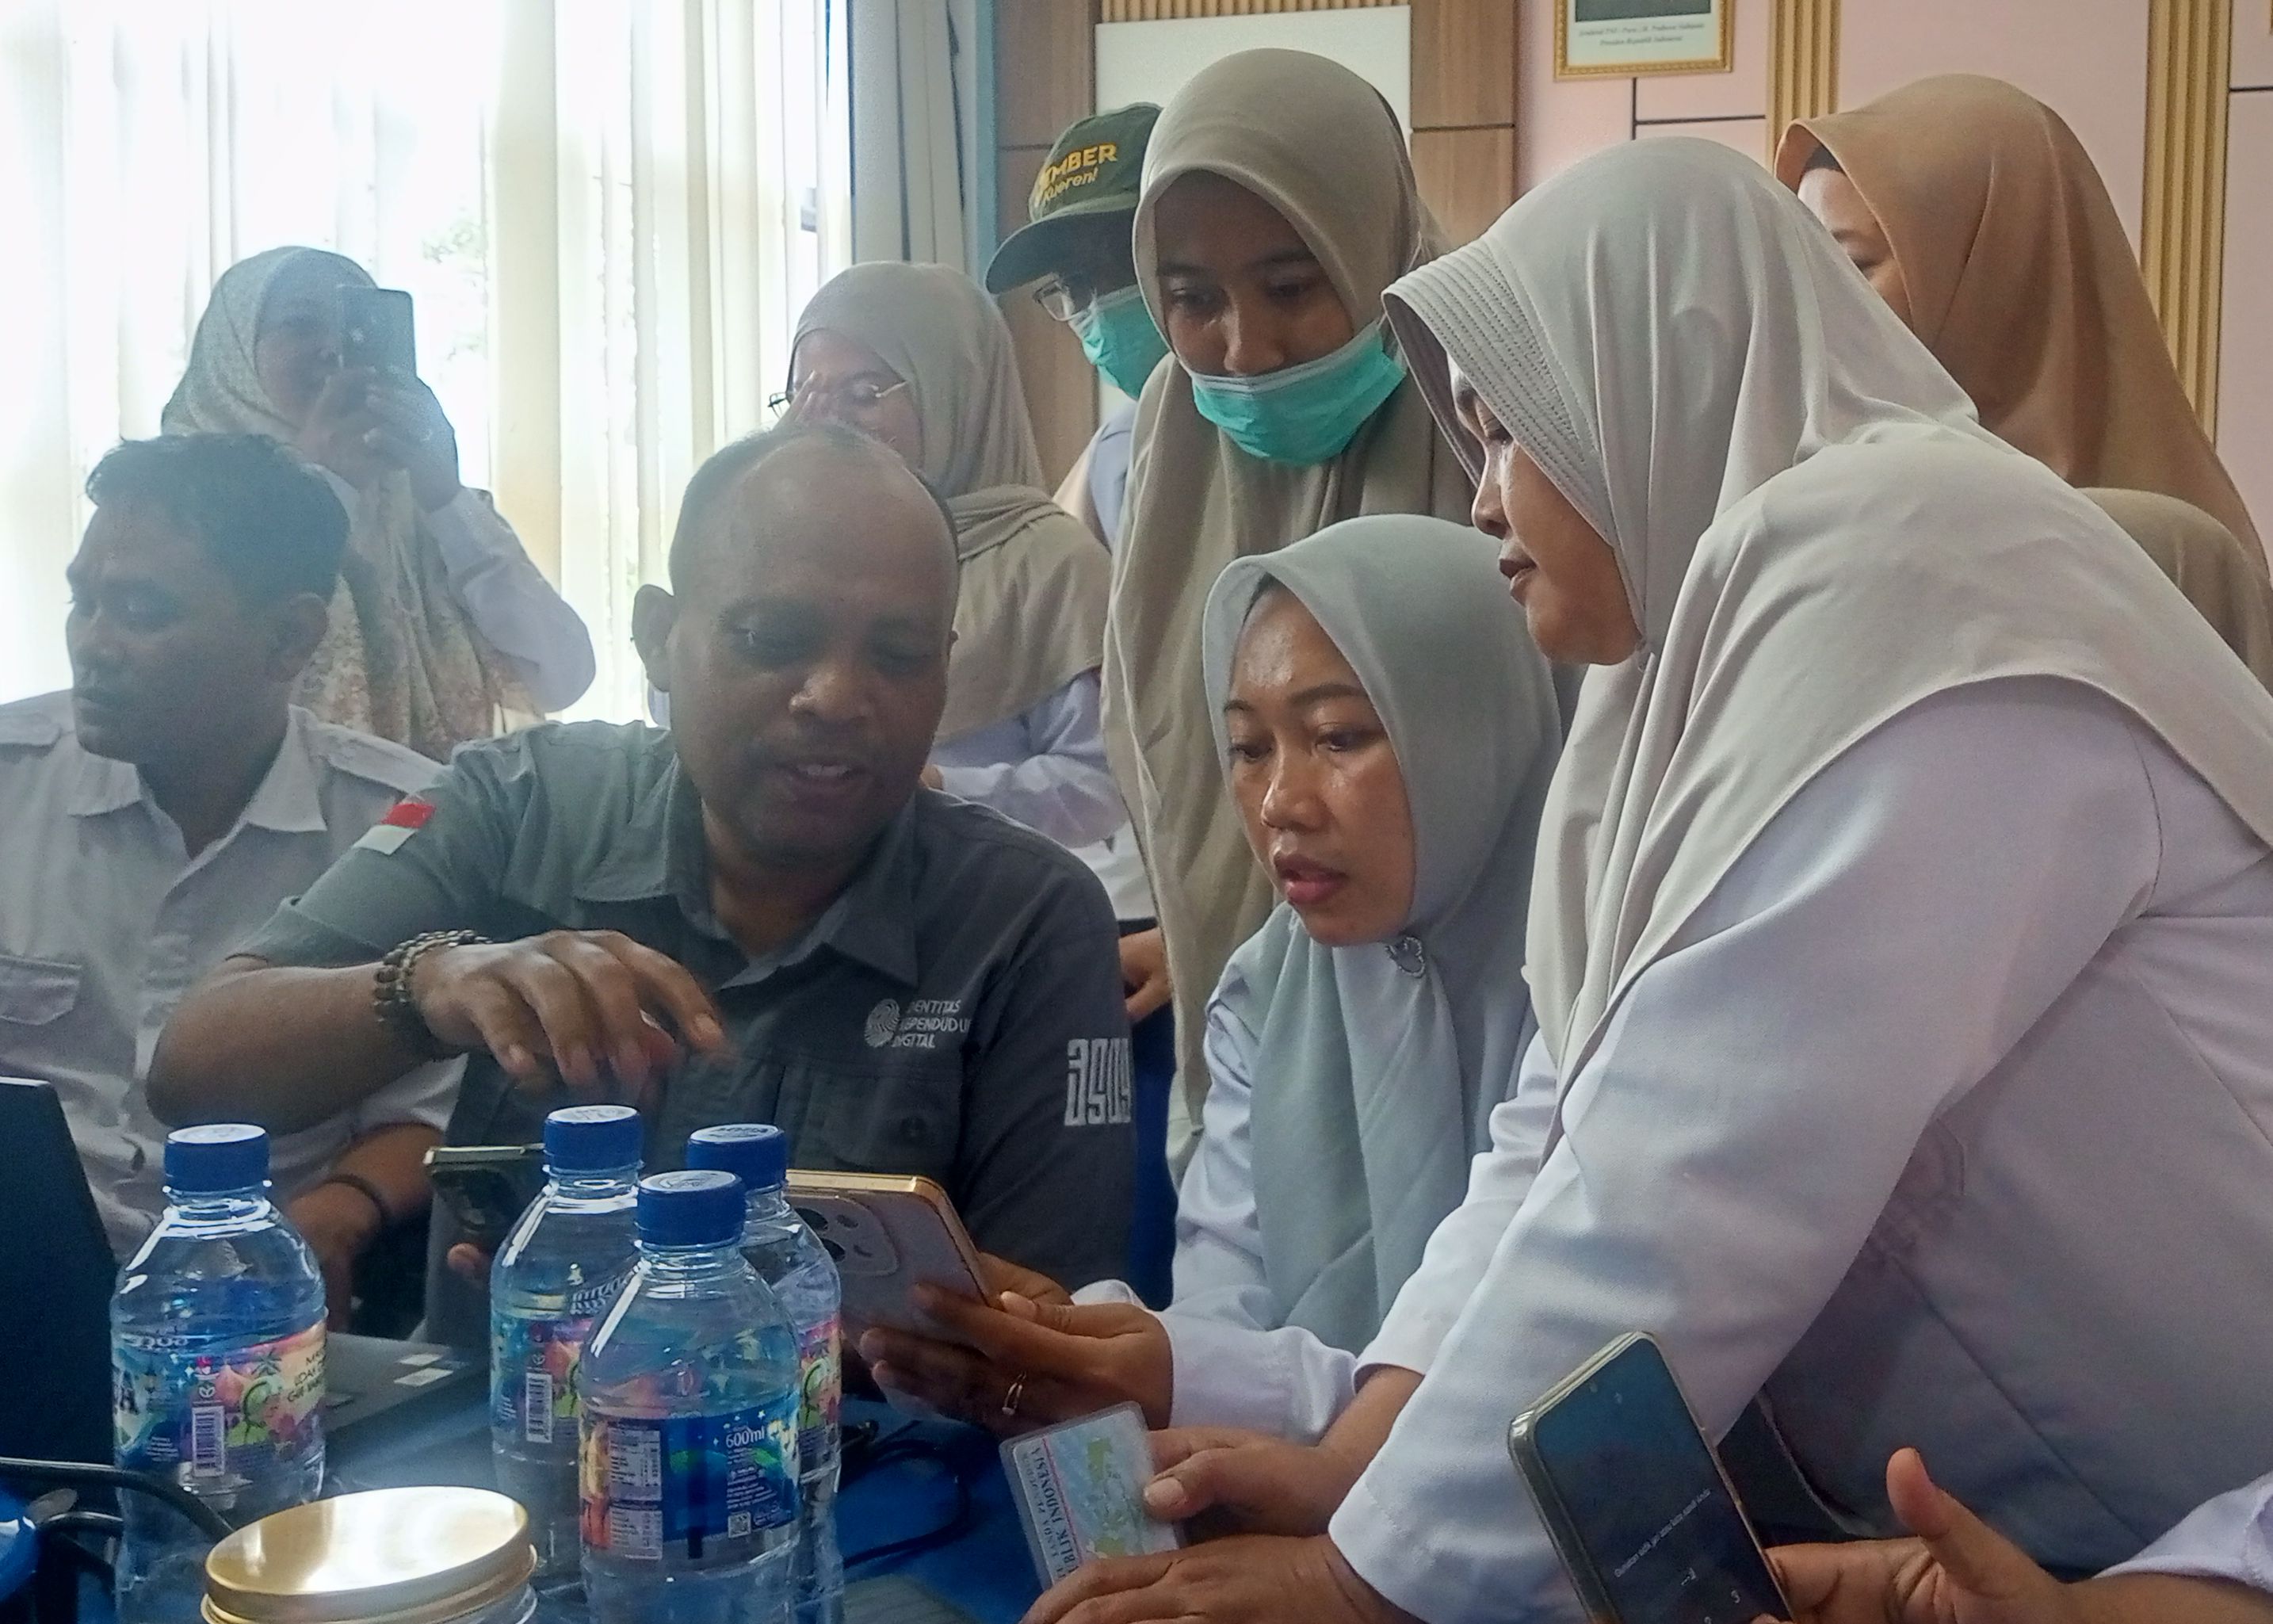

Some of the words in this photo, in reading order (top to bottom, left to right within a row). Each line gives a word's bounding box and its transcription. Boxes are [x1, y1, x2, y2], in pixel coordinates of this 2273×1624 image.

[907, 999, 961, 1014] ENTITAS
[726, 1426, 765, 1448] 600ml
[1031, 1446, 1063, 1523] INDONESIA
